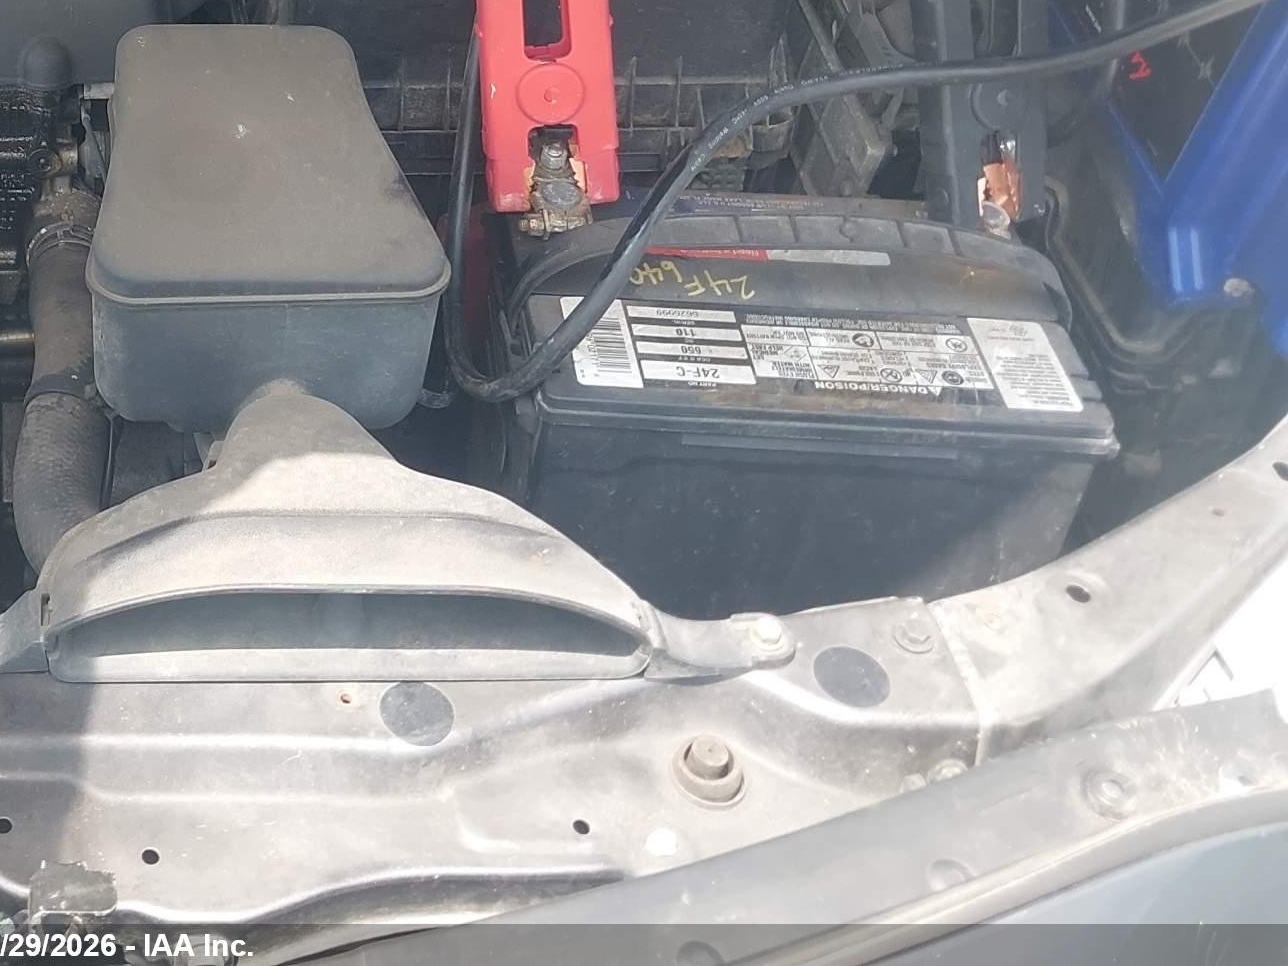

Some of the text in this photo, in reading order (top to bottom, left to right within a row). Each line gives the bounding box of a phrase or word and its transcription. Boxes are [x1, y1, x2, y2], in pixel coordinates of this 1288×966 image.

[684, 270, 756, 300] 24F
[676, 327, 697, 337] 110
[680, 345, 702, 355] 650
[675, 365, 720, 379] 24F-C
[813, 381, 929, 394] DANGER/POISON
